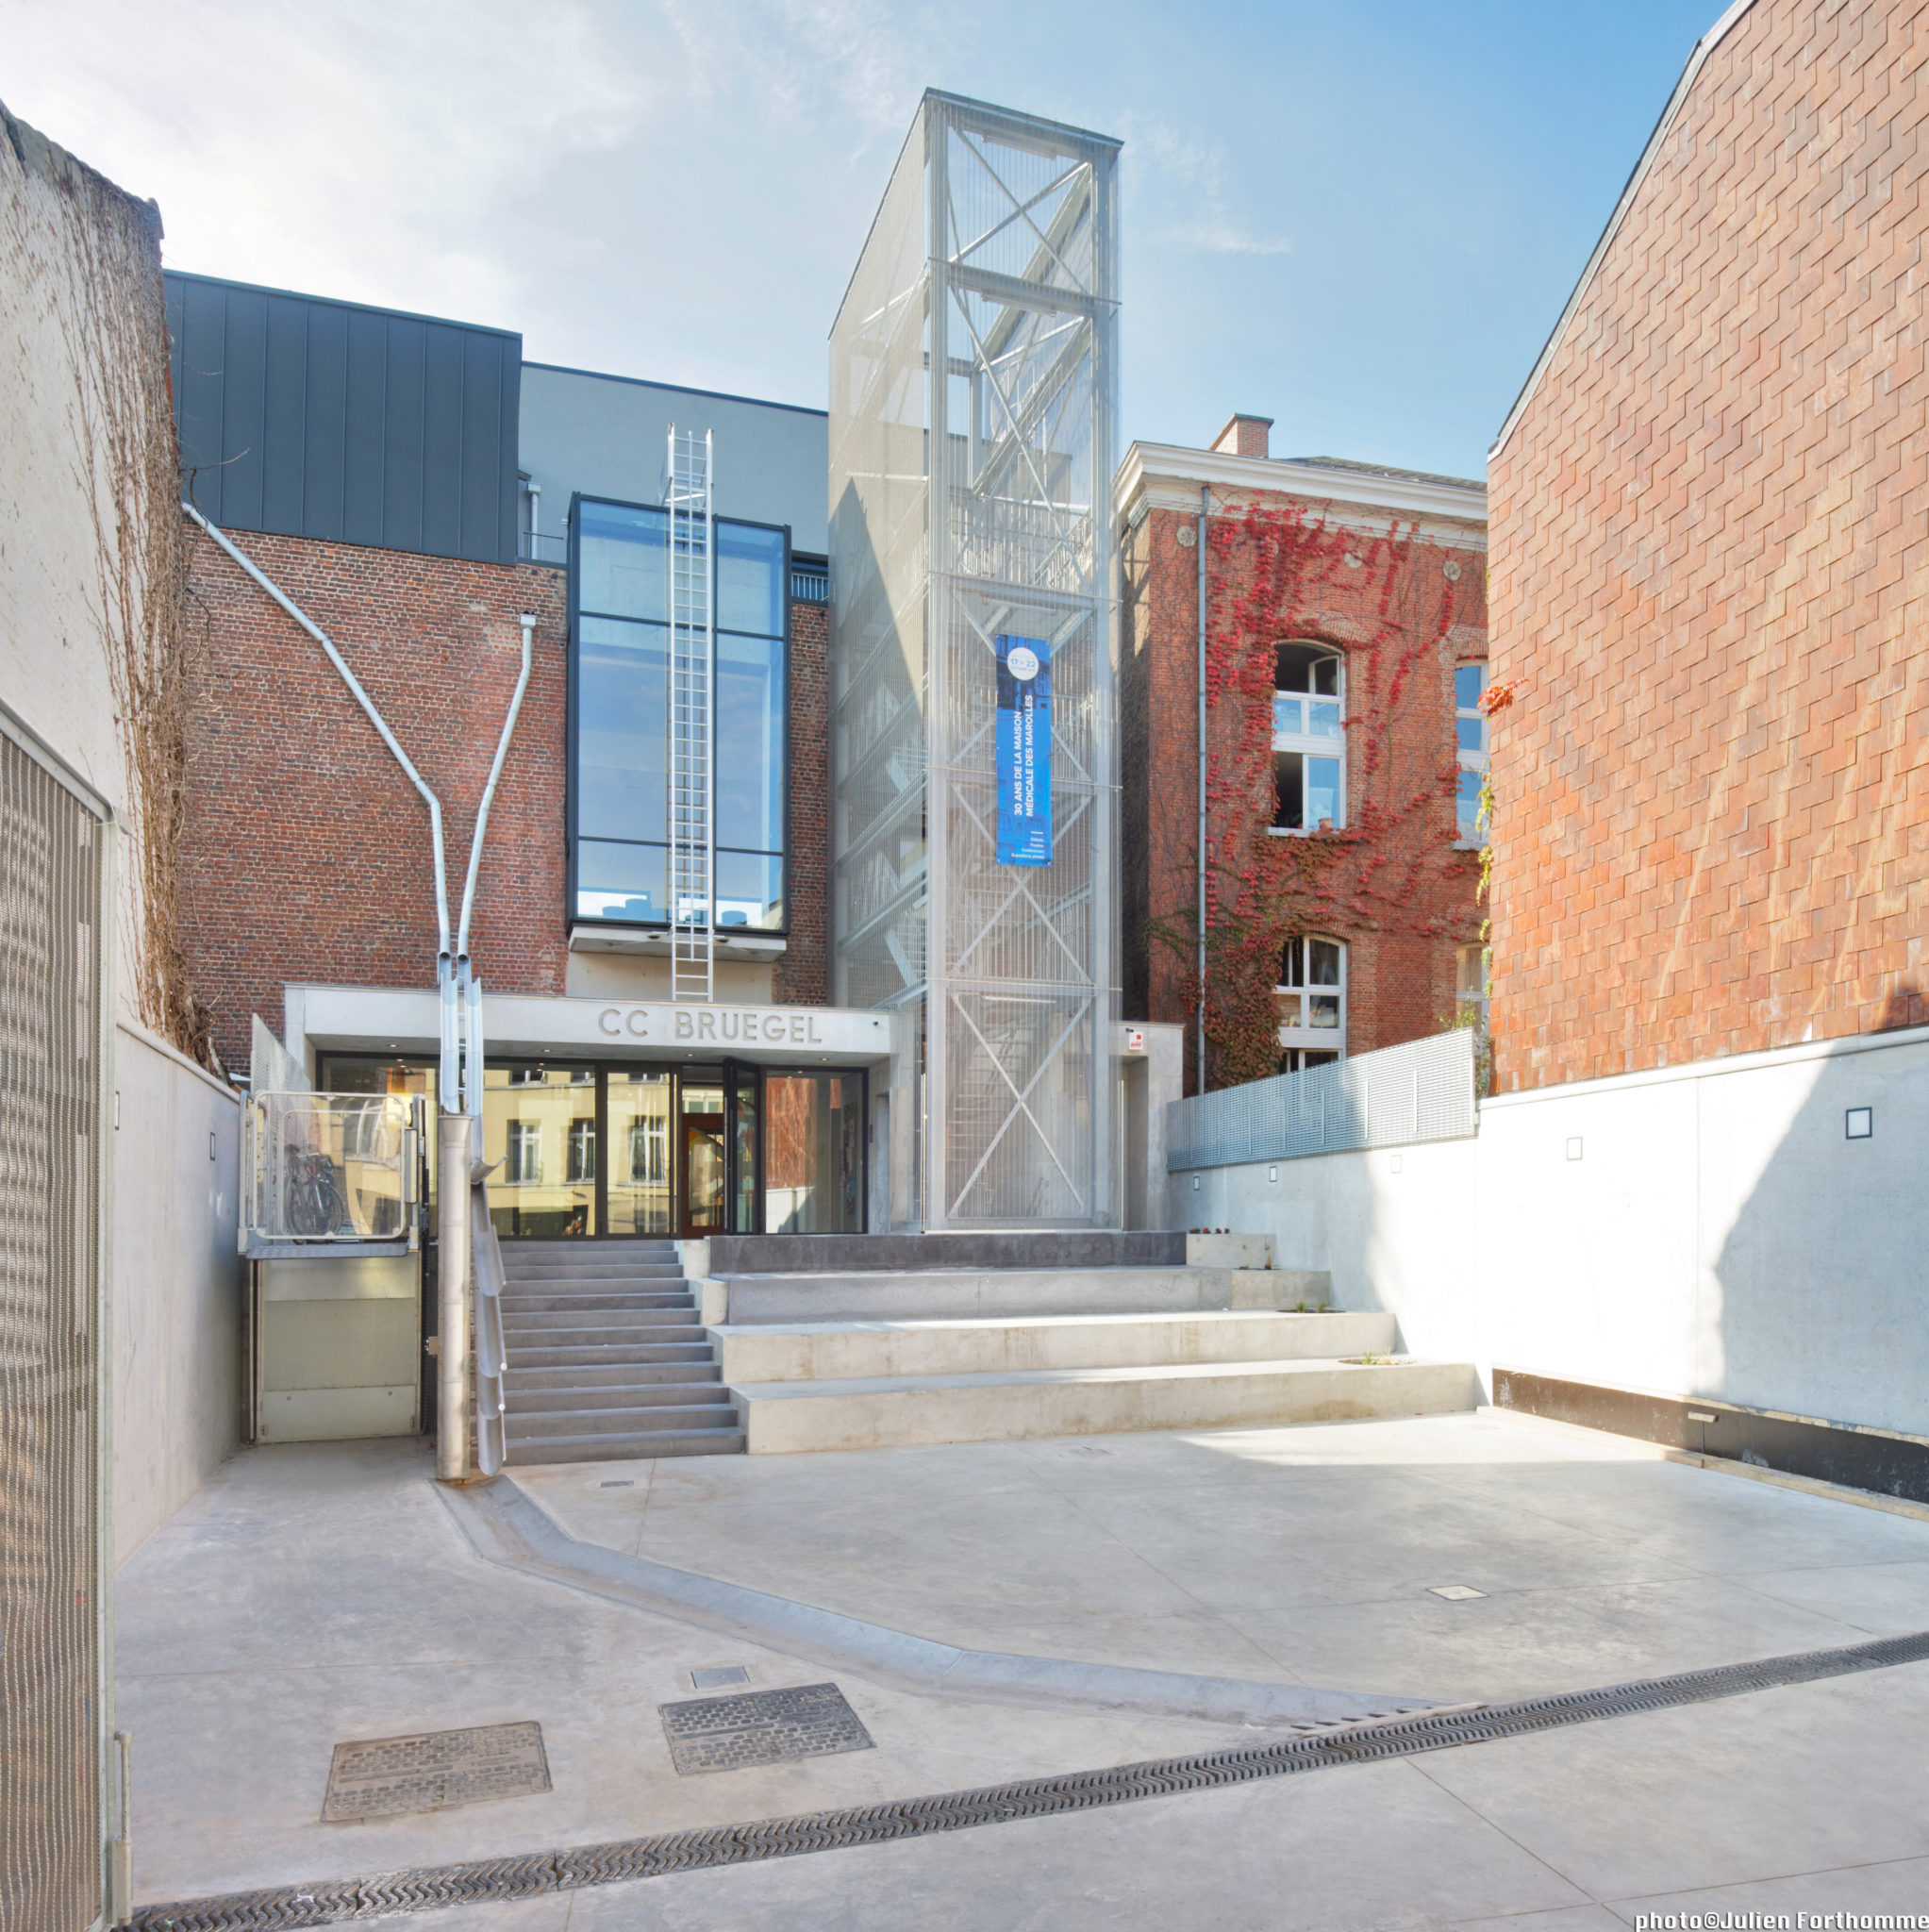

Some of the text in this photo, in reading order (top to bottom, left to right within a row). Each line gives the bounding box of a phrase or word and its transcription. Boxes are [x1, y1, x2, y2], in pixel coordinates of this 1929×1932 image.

[1014, 711, 1023, 816] 30 ANS DE LA MAISON
[1023, 694, 1034, 817] MÉDICALE DES MAROLLES
[597, 1008, 823, 1044] CC BRUEGEL
